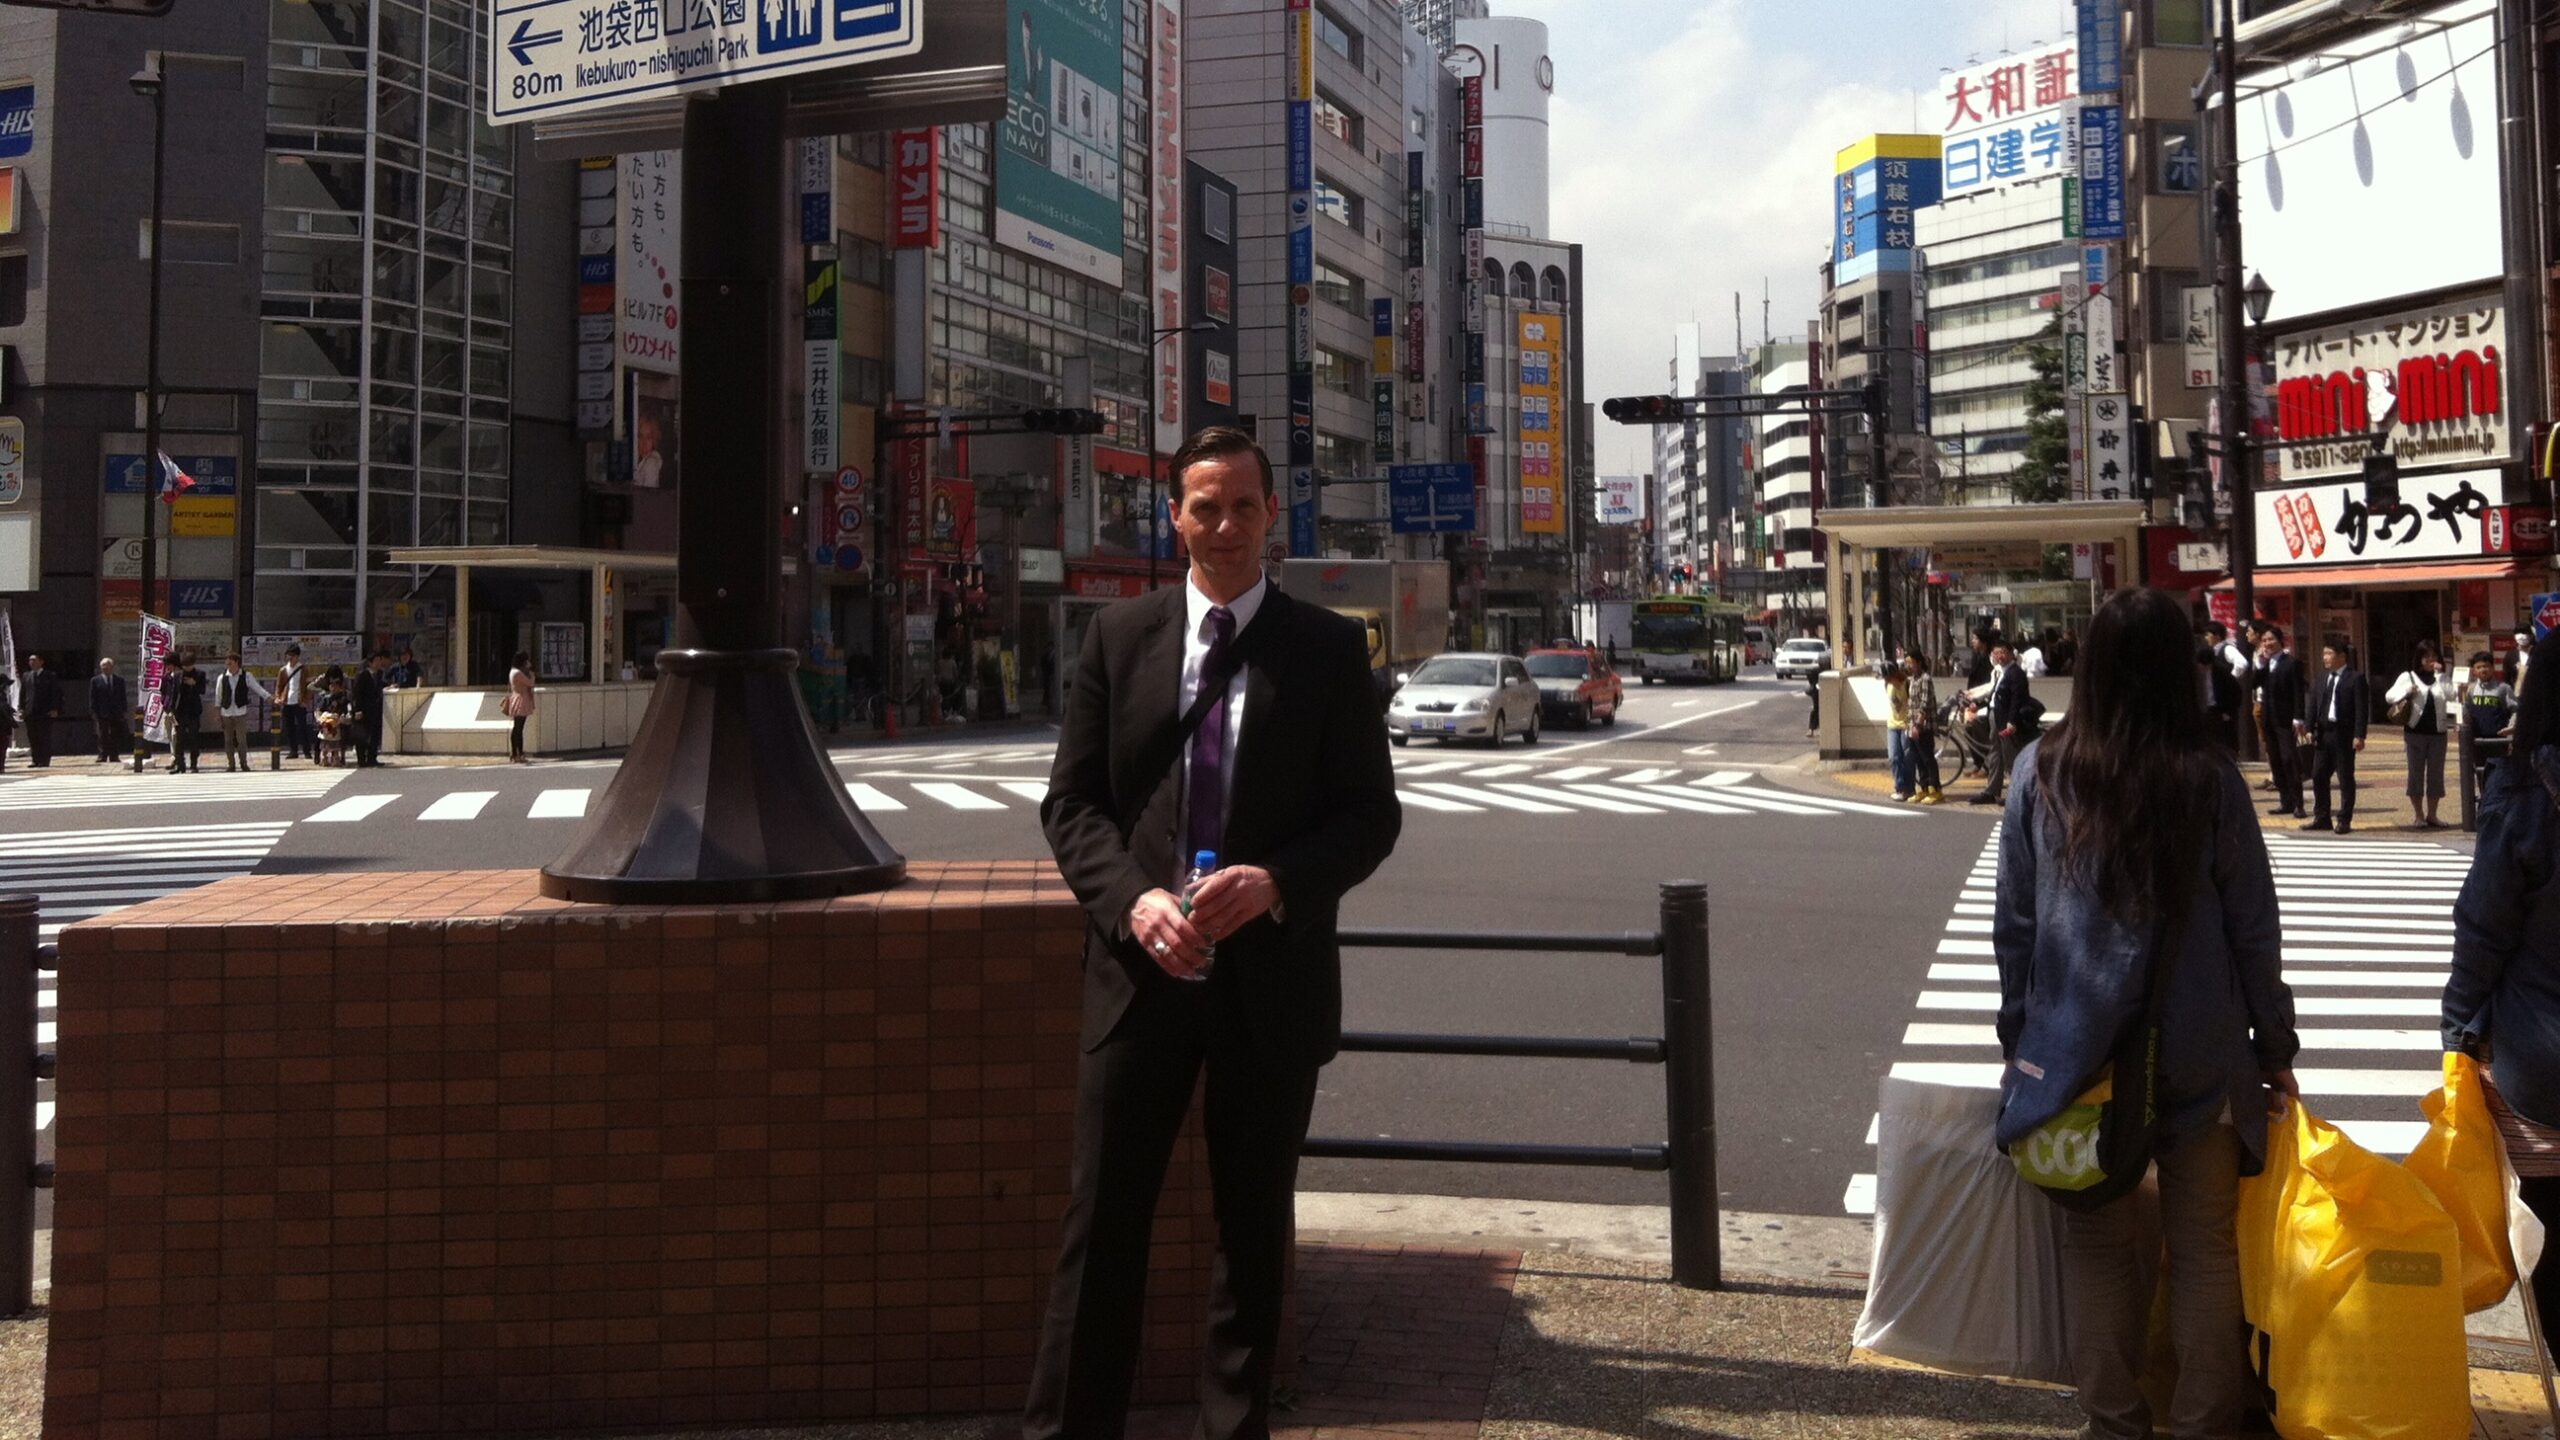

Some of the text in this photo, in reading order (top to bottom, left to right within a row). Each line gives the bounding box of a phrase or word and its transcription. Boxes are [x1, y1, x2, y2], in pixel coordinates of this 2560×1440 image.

[577, 0, 746, 54] 池袋西口公園
[718, 36, 749, 62] Park
[512, 73, 563, 99] 80m
[1006, 97, 1046, 138] ECO
[1006, 127, 1045, 159] NAVI
[806, 305, 835, 319] SMBC
[2191, 369, 2212, 385] B1
[810, 346, 829, 467] 三井住友銀行
[1292, 394, 1311, 446] TBC
[1375, 410, 1392, 445] 歯科
[841, 474, 859, 488] 40
[1071, 459, 1081, 499] SELECT
[182, 587, 223, 604] HIS
